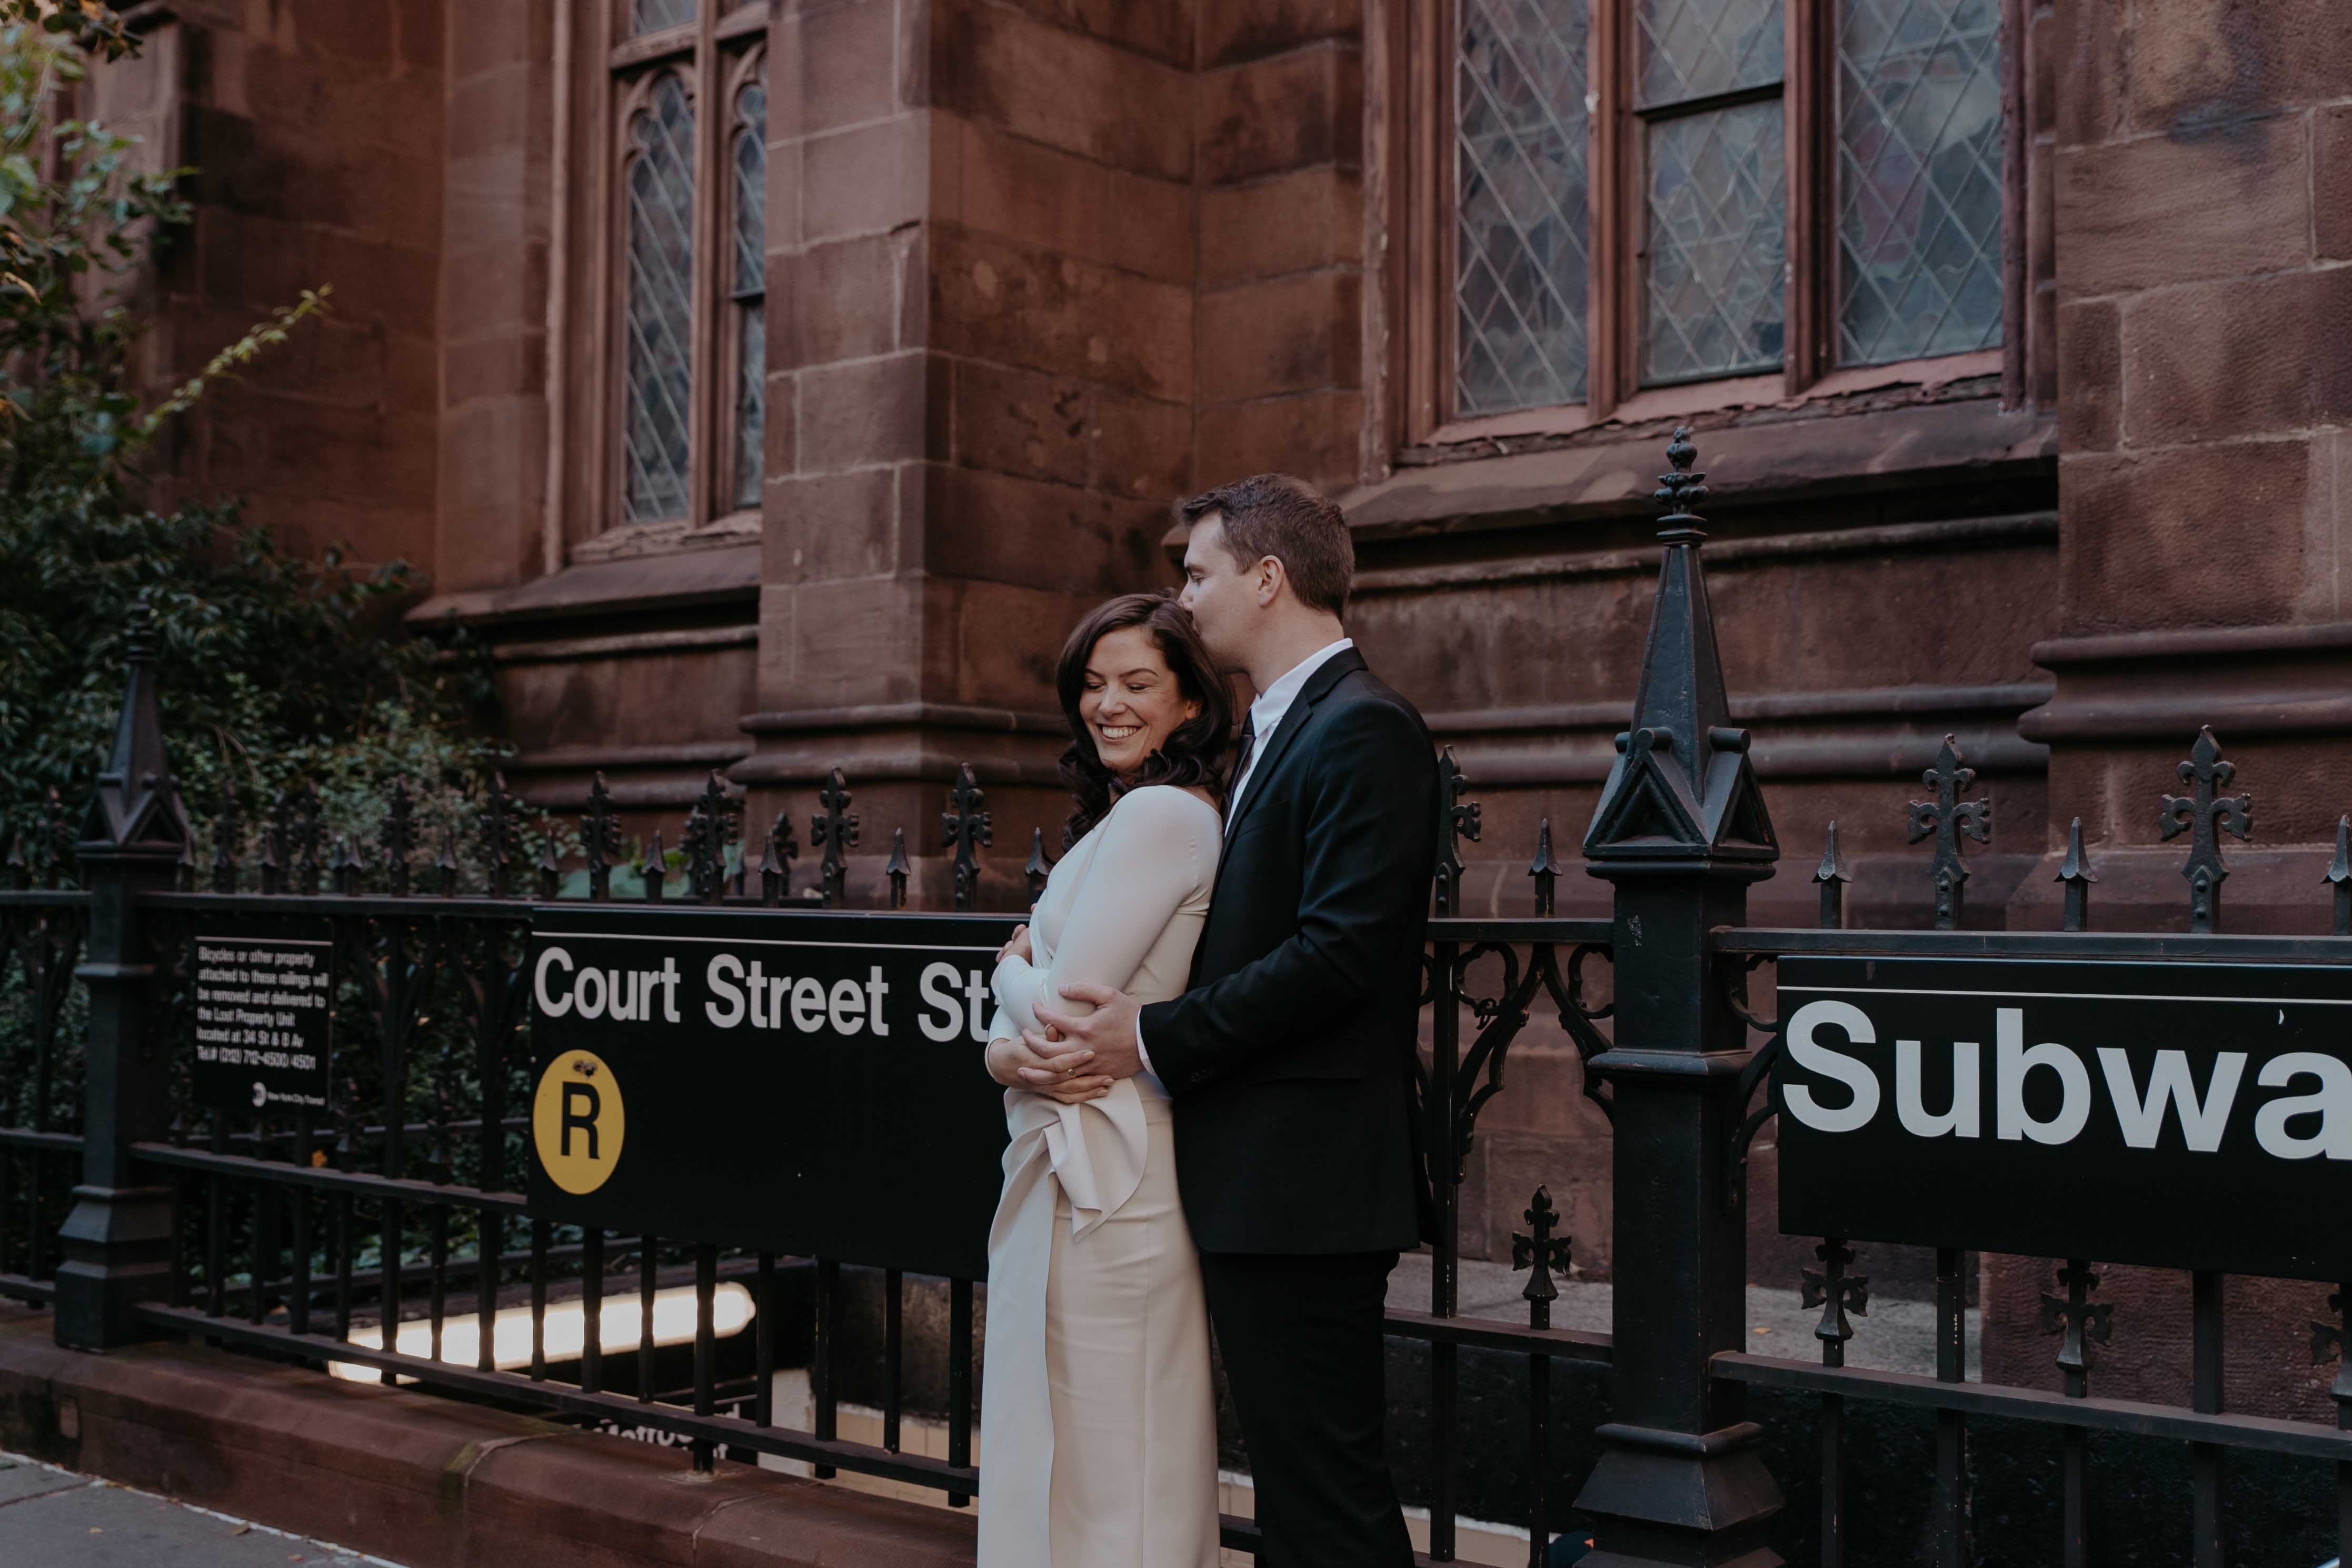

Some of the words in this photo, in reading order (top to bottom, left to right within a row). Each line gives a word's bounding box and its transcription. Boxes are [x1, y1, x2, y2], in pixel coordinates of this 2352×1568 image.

[199, 947, 235, 964] Bicycles
[237, 952, 247, 962] or
[250, 950, 273, 964] other
[275, 953, 315, 968] property
[199, 968, 238, 982] attached
[240, 970, 250, 983] to
[252, 971, 277, 985] these
[279, 972, 311, 989] railings
[313, 973, 328, 987] will
[198, 987, 210, 1001] be
[212, 990, 251, 1003] removed
[252, 992, 270, 1005] and
[272, 992, 313, 1007] delivered
[315, 995, 325, 1008] to
[535, 947, 680, 1022] Court
[705, 954, 889, 1035] Street
[919, 962, 1000, 1042] St
[197, 1007, 212, 1021] the
[214, 1008, 234, 1022] Lost
[236, 1009, 274, 1027] Property
[276, 1012, 295, 1027] Unit
[197, 1027, 230, 1042] located
[232, 1030, 241, 1043] at
[243, 1030, 256, 1044] 34
[258, 1031, 270, 1045] St
[272, 1032, 279, 1046] &
[292, 1034, 304, 1048] Av
[1783, 1000, 2352, 1160] Subwa
[562, 1082, 600, 1159] R
